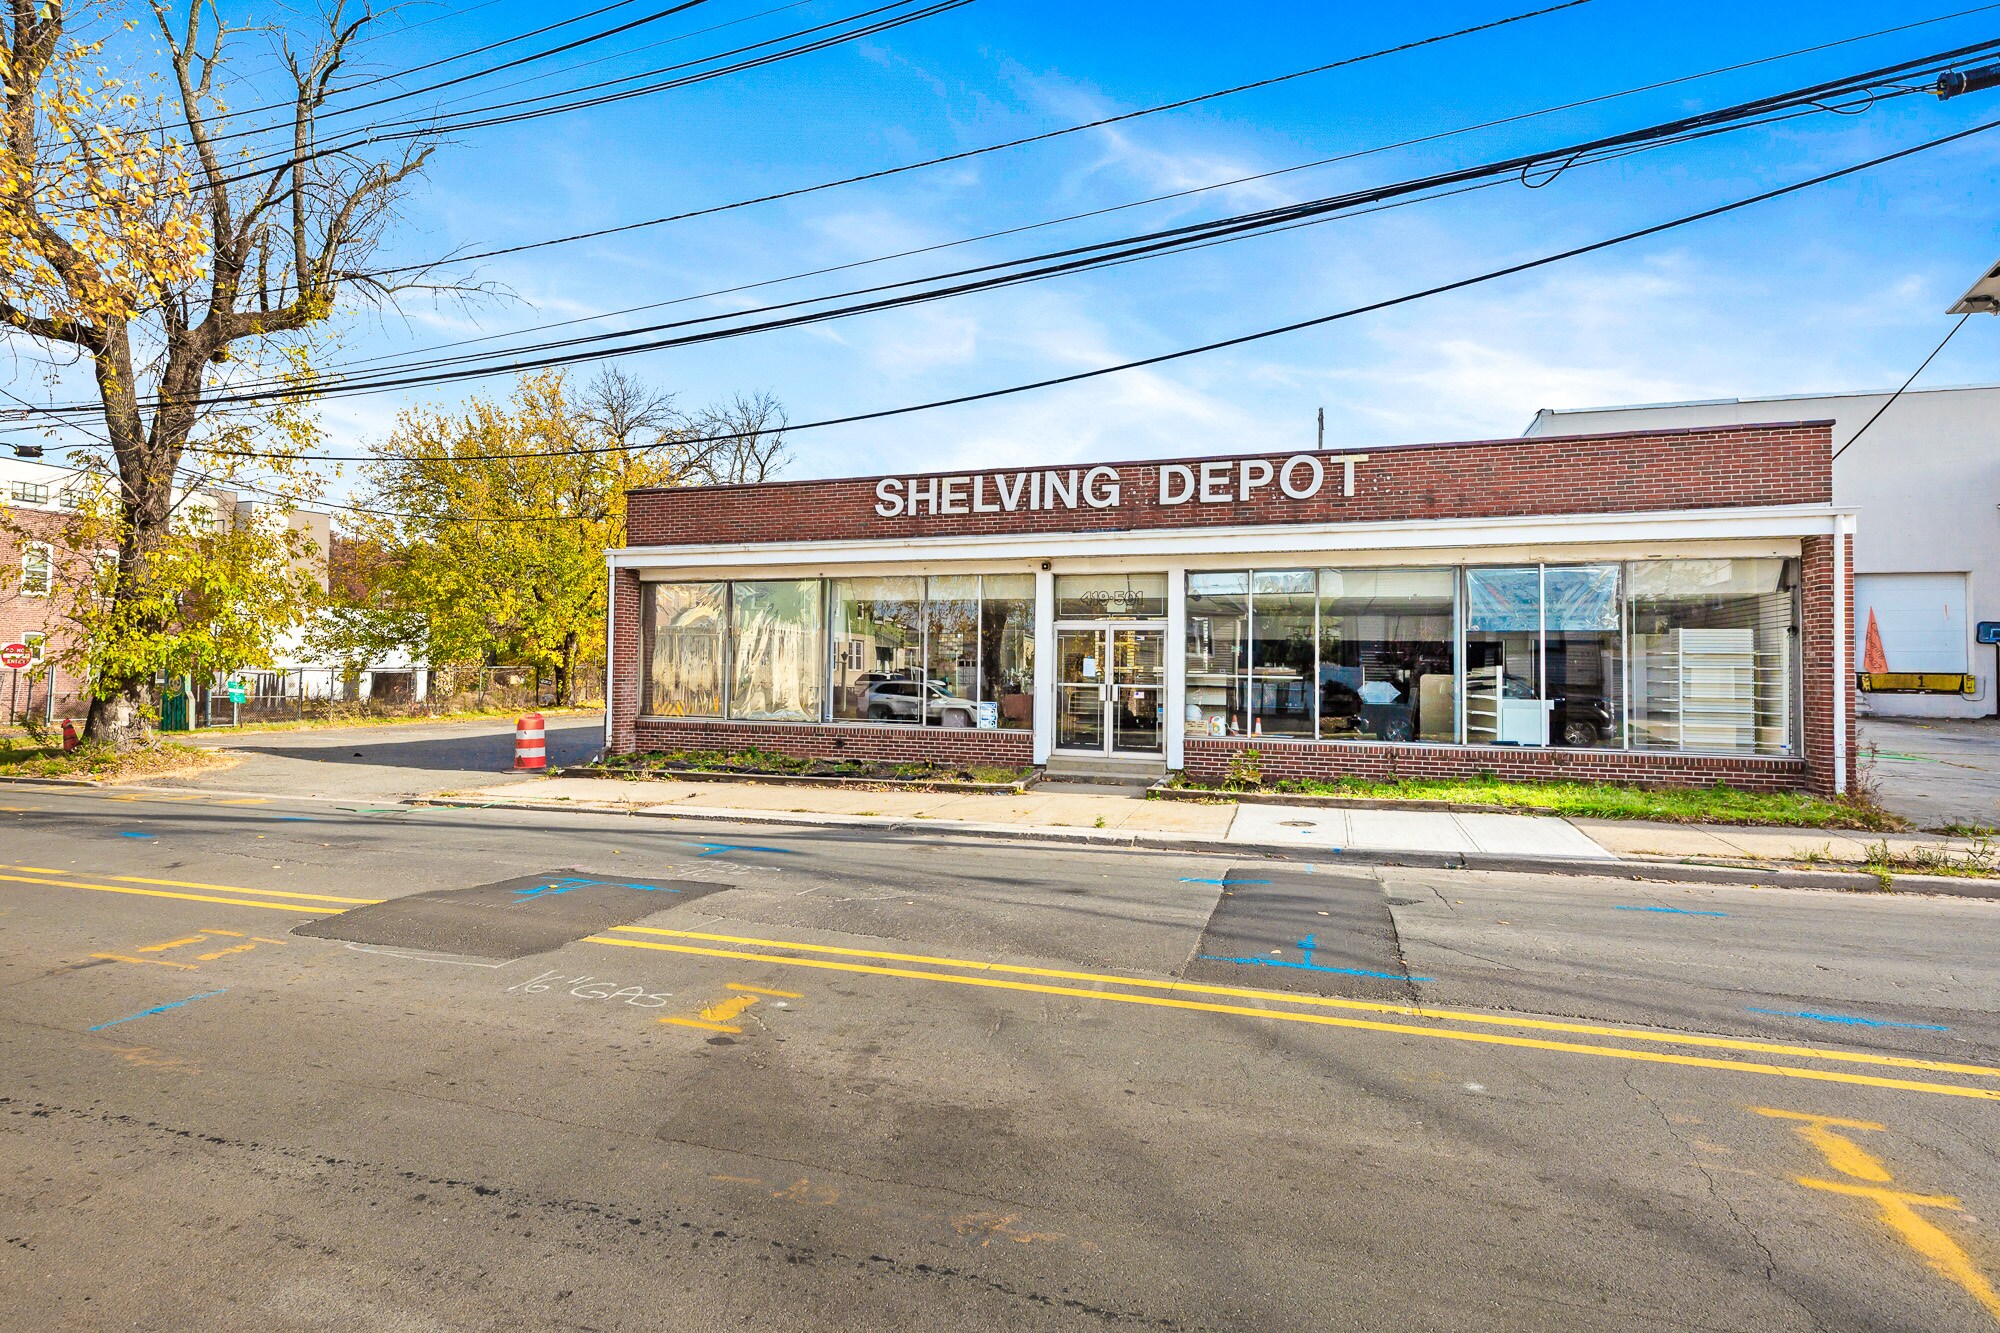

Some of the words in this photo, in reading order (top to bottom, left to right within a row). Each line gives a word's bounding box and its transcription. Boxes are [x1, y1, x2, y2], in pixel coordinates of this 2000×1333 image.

[875, 466, 1120, 518] SHELVING
[1159, 454, 1369, 505] DEPOT
[1918, 675, 1926, 687] 1
[570, 982, 674, 1008] GAS
